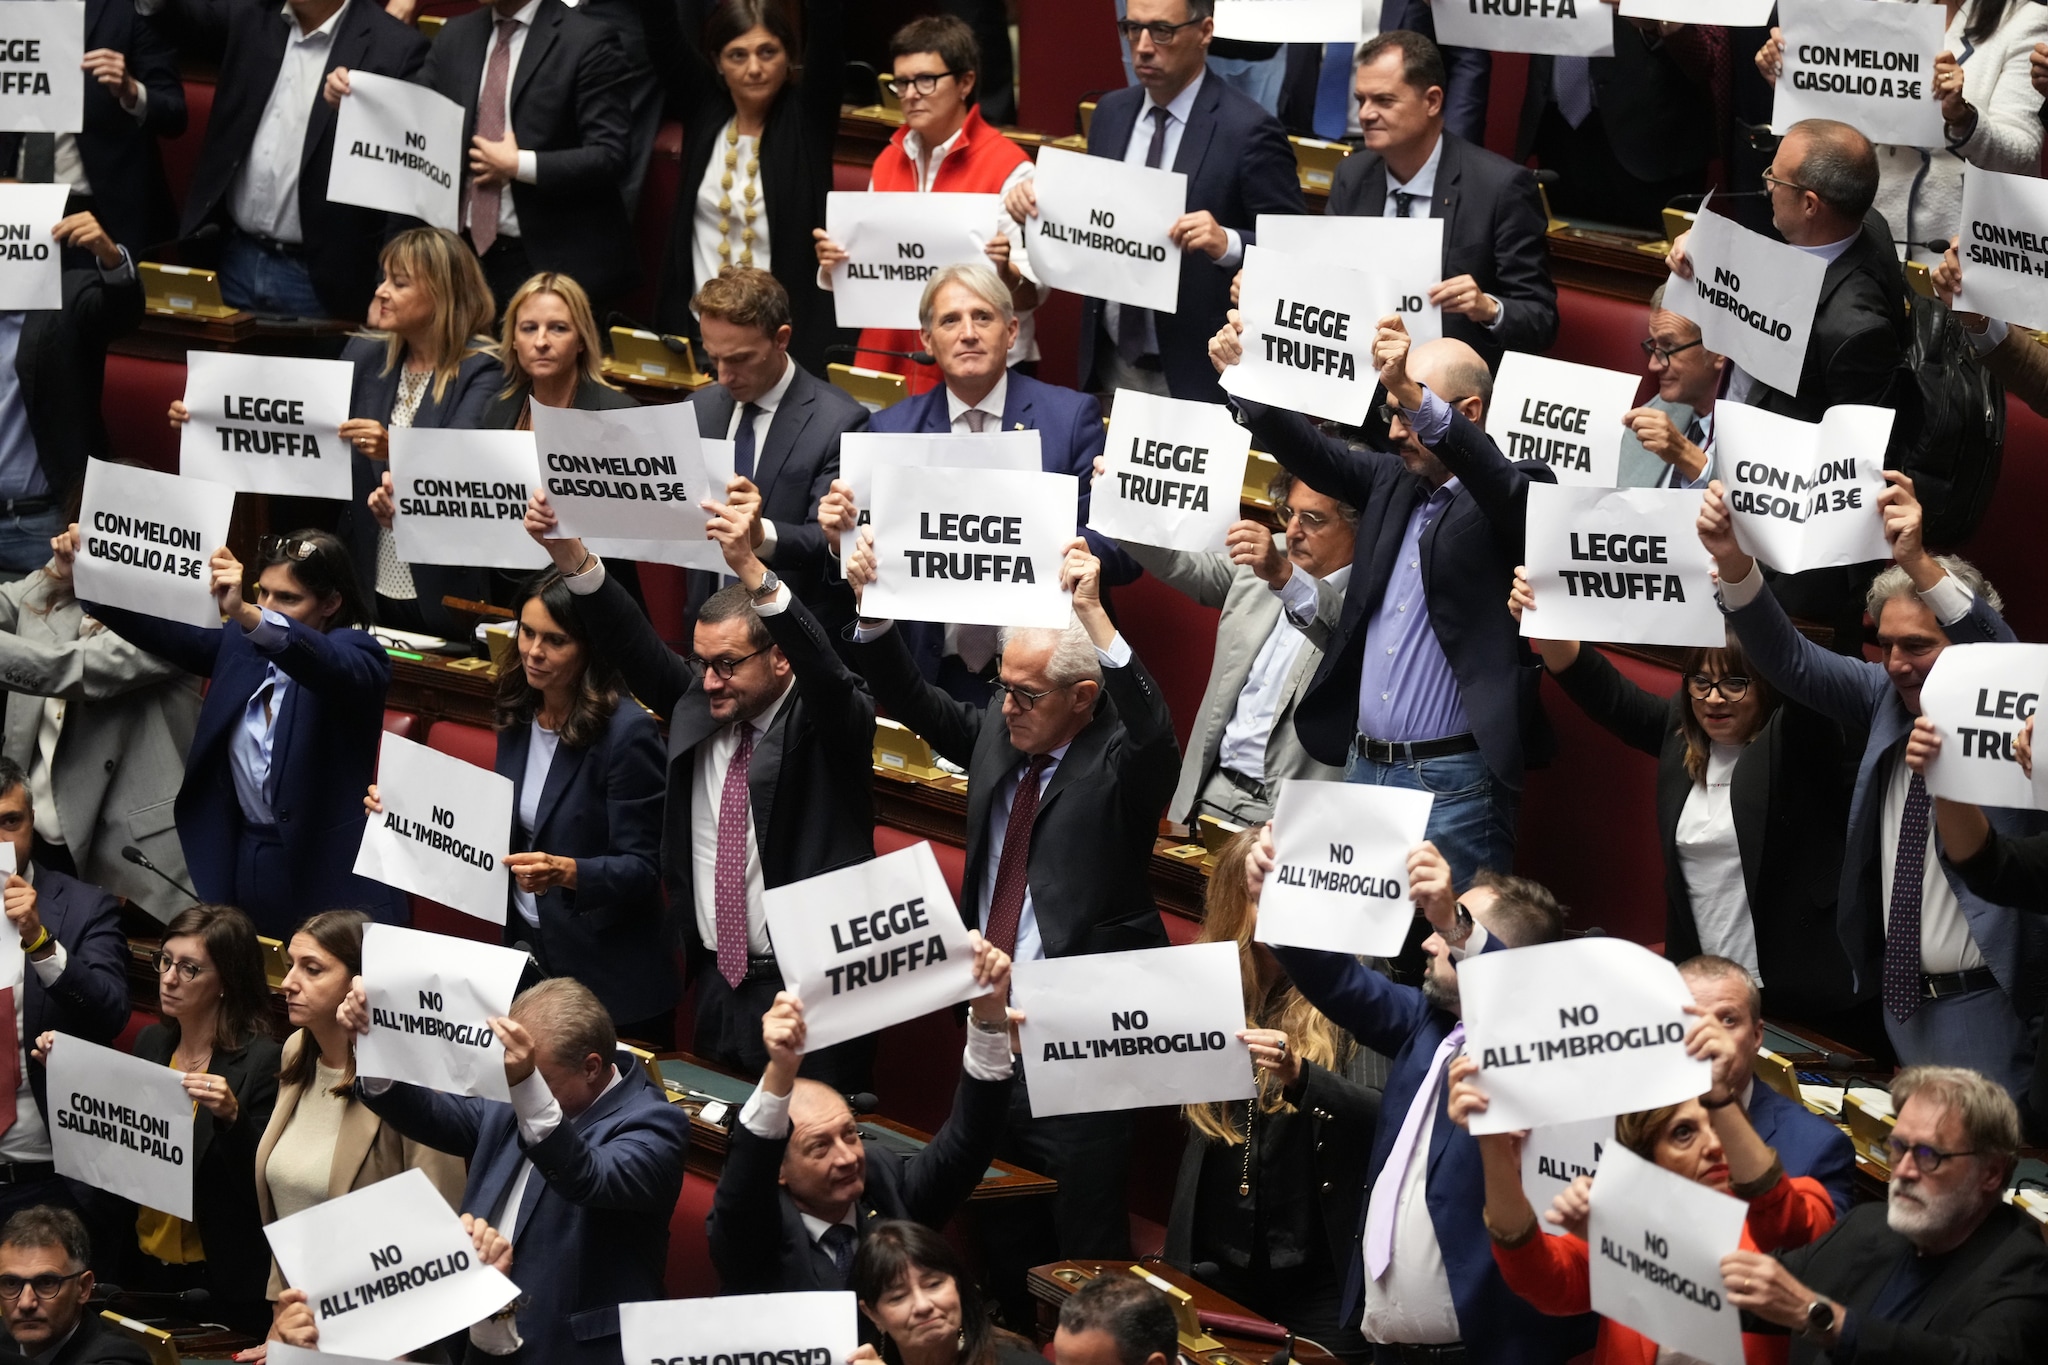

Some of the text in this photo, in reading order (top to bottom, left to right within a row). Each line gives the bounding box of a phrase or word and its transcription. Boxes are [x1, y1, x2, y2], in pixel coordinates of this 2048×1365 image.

[1799, 45, 1919, 73] CON MELONI
[1793, 71, 1921, 100] GASOLIO A 3€
[405, 131, 426, 151] NO
[351, 141, 451, 189] ALL'IMBROGLIO
[1090, 209, 1114, 228] NO
[898, 243, 924, 259] NO
[1040, 220, 1166, 262] ALL'IMBROGLIO
[1972, 221, 2048, 255] CON MELO
[847, 263, 938, 281] ALL'IMBR
[1714, 266, 1740, 292] NO
[1274, 299, 1350, 341] LEGGE
[1696, 277, 1791, 341] 'IMBROGLIO
[1261, 333, 1355, 381] TRUFFA
[224, 395, 304, 426] LEGGE
[1520, 398, 1590, 435] LEGGE
[216, 426, 321, 459] TRUFFA
[1130, 437, 1209, 474] LEGGE
[1507, 431, 1591, 473] TRUFFA
[547, 453, 677, 476] CON MELONI
[1736, 461, 1790, 490] CON
[413, 479, 527, 501] CON MELONI
[548, 478, 687, 502] GASOLIO A 3€
[1117, 472, 1208, 512] TRUFFA
[1814, 493, 1828, 515] A
[1832, 488, 1862, 511] 3€
[400, 498, 468, 518] SALARI
[471, 502, 495, 519] AL
[94, 511, 201, 552] CON MELONI
[920, 512, 1022, 545] LEGGE
[88, 537, 202, 579] GASOLIO A 3€
[1570, 532, 1668, 564] LEGGE
[904, 550, 1035, 584] TRUFFA
[1558, 570, 1686, 603] TRUFFA
[1976, 688, 2039, 721] LEG
[432, 805, 454, 829] NO
[384, 812, 494, 871] ALL'IMBROGLIO
[1330, 843, 1353, 865] NO
[1277, 865, 1401, 900] ALL'IMBROGLIO
[831, 897, 929, 953] LEGGE
[825, 935, 948, 996] TRUFFA
[419, 990, 443, 1012] NO
[1559, 1005, 1598, 1028] NO
[372, 1007, 494, 1048] ALL'IMBROGLIO
[1112, 1010, 1148, 1031] NO
[1043, 1031, 1226, 1062] ALL'IMBROGLIO
[1482, 1022, 1684, 1070] ALL'IMBROGLIO
[71, 1092, 169, 1140] CON MELONI
[57, 1109, 183, 1165] SALARI AL PALO
[370, 1245, 402, 1271] NO
[1645, 1231, 1668, 1260] NO
[320, 1251, 469, 1320] ALL'IMBROGLIO
[1601, 1237, 1721, 1312] ALL'IMBROGLIO
